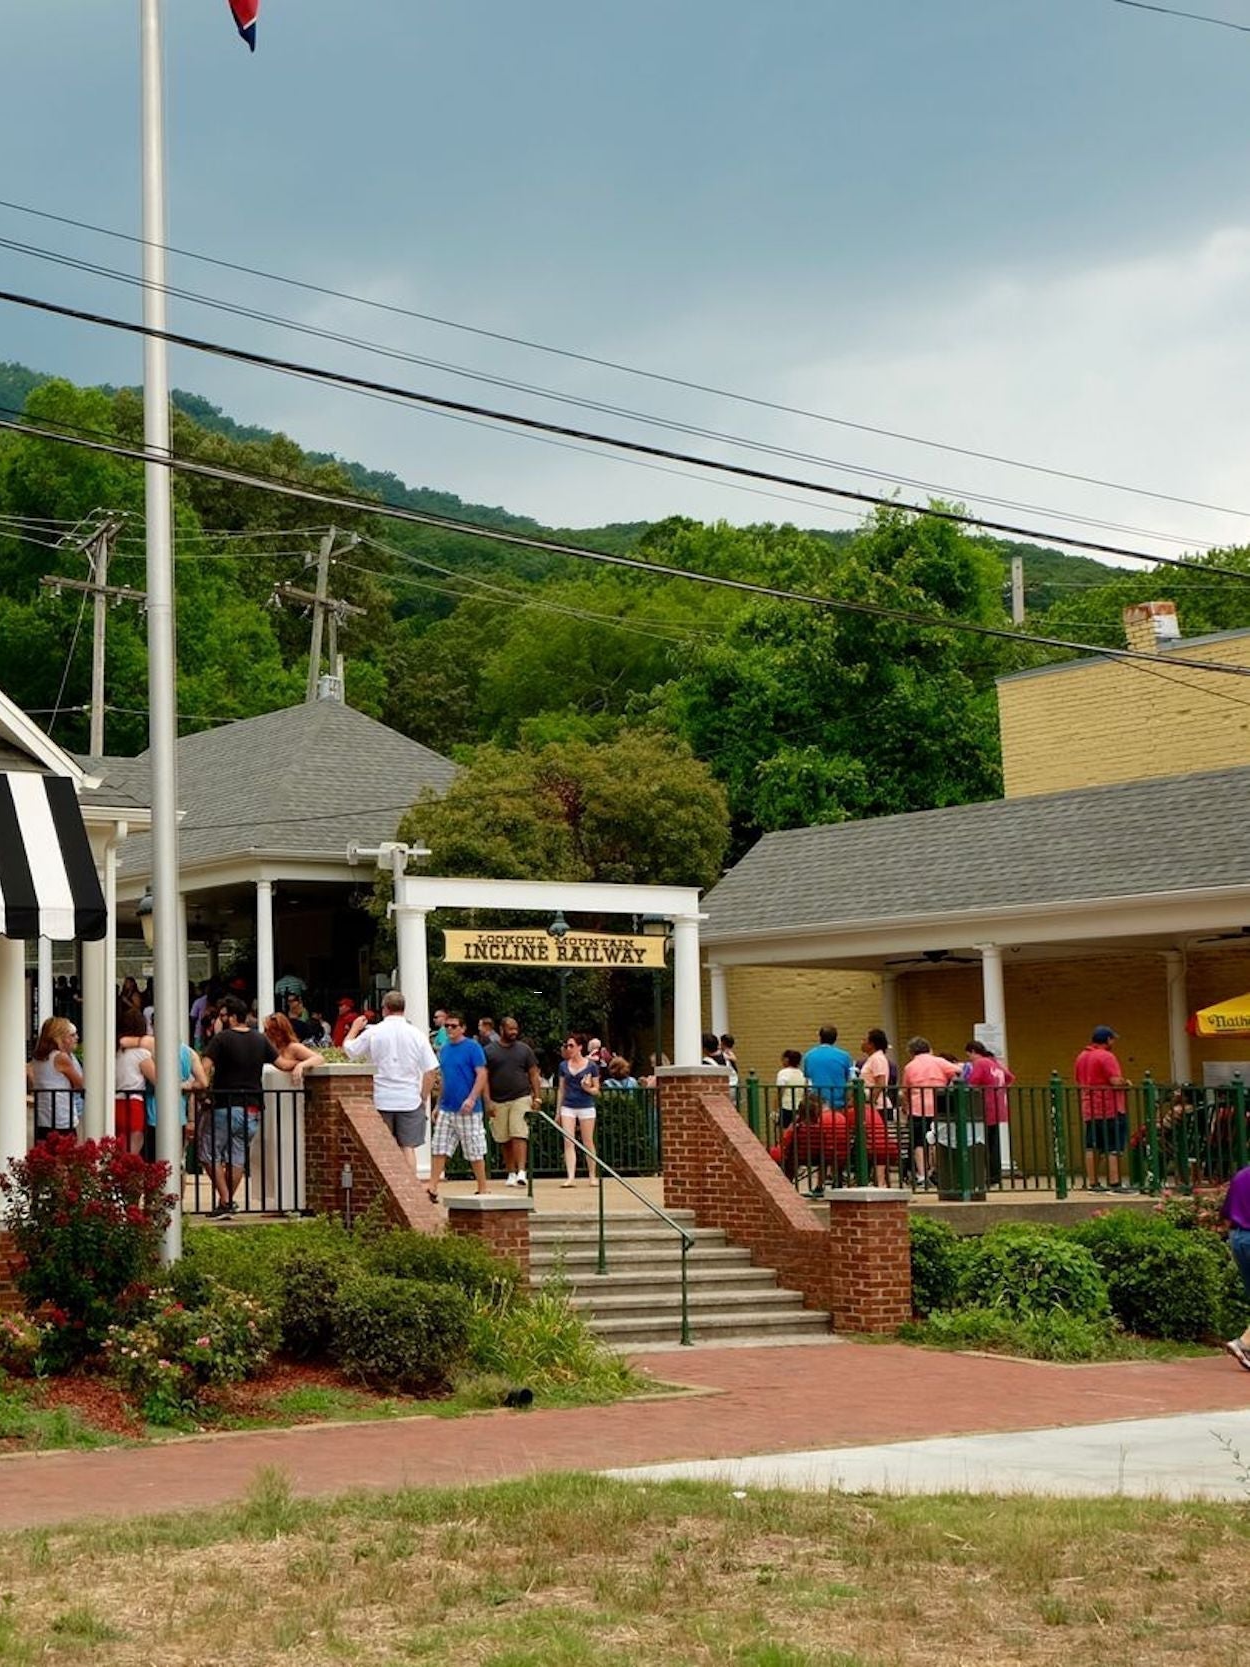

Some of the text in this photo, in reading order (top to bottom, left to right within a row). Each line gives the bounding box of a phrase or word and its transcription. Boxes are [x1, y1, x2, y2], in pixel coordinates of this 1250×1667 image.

[477, 934, 635, 948] LOOKOUT MOUNTAIN
[464, 943, 647, 963] INCLINE RAILWAY
